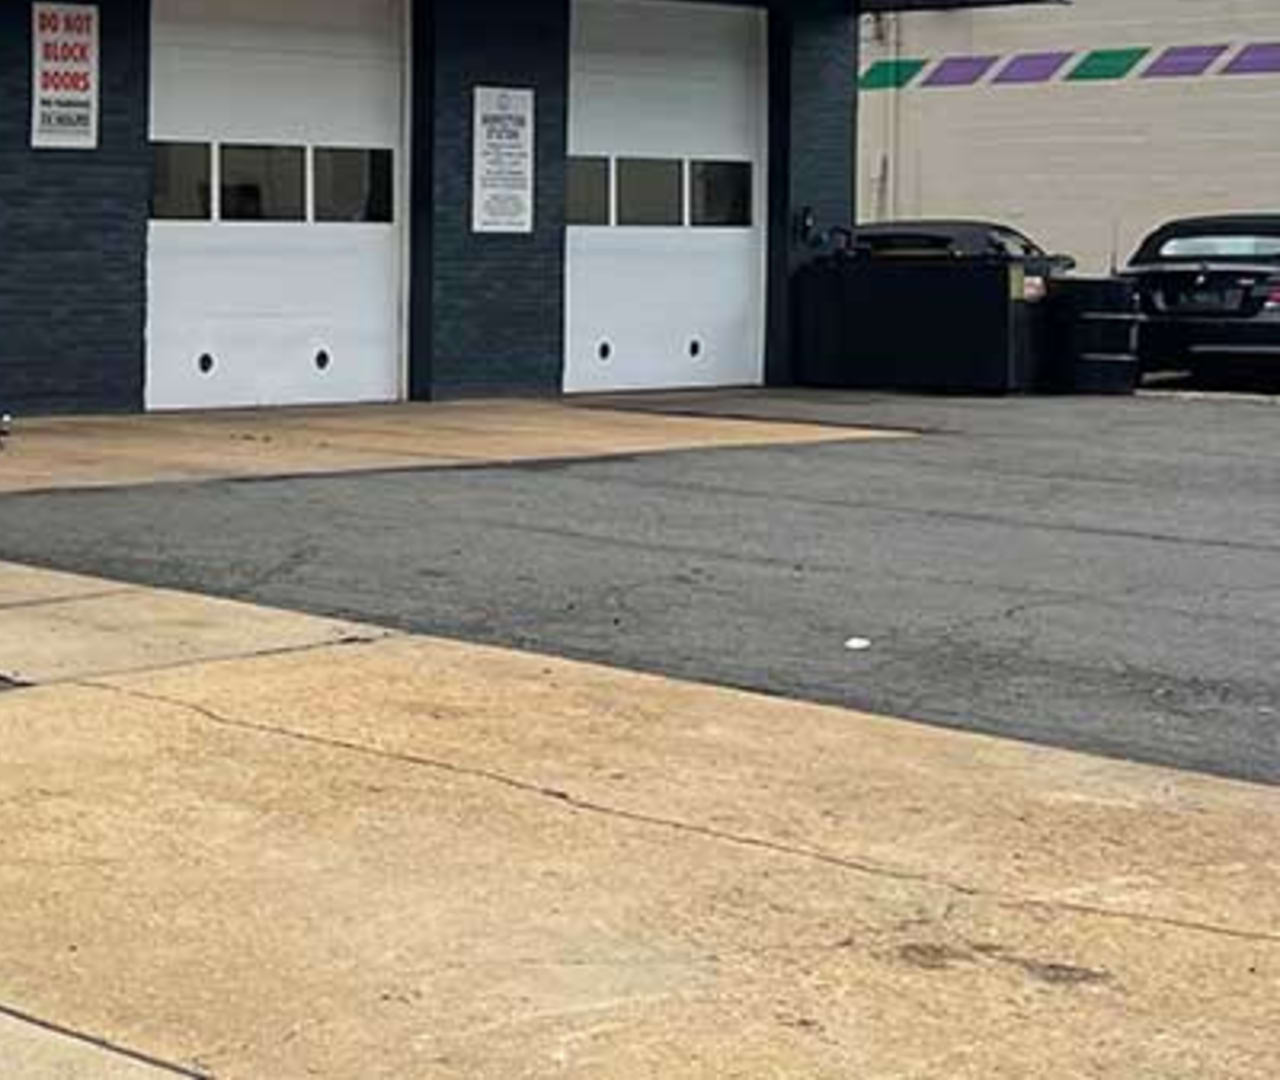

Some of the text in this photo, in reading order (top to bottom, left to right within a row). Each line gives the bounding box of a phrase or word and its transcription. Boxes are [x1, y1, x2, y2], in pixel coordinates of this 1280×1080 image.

[39, 11, 91, 35] DO NOT
[43, 41, 88, 63] BLOCK
[41, 70, 90, 92] DOORS
